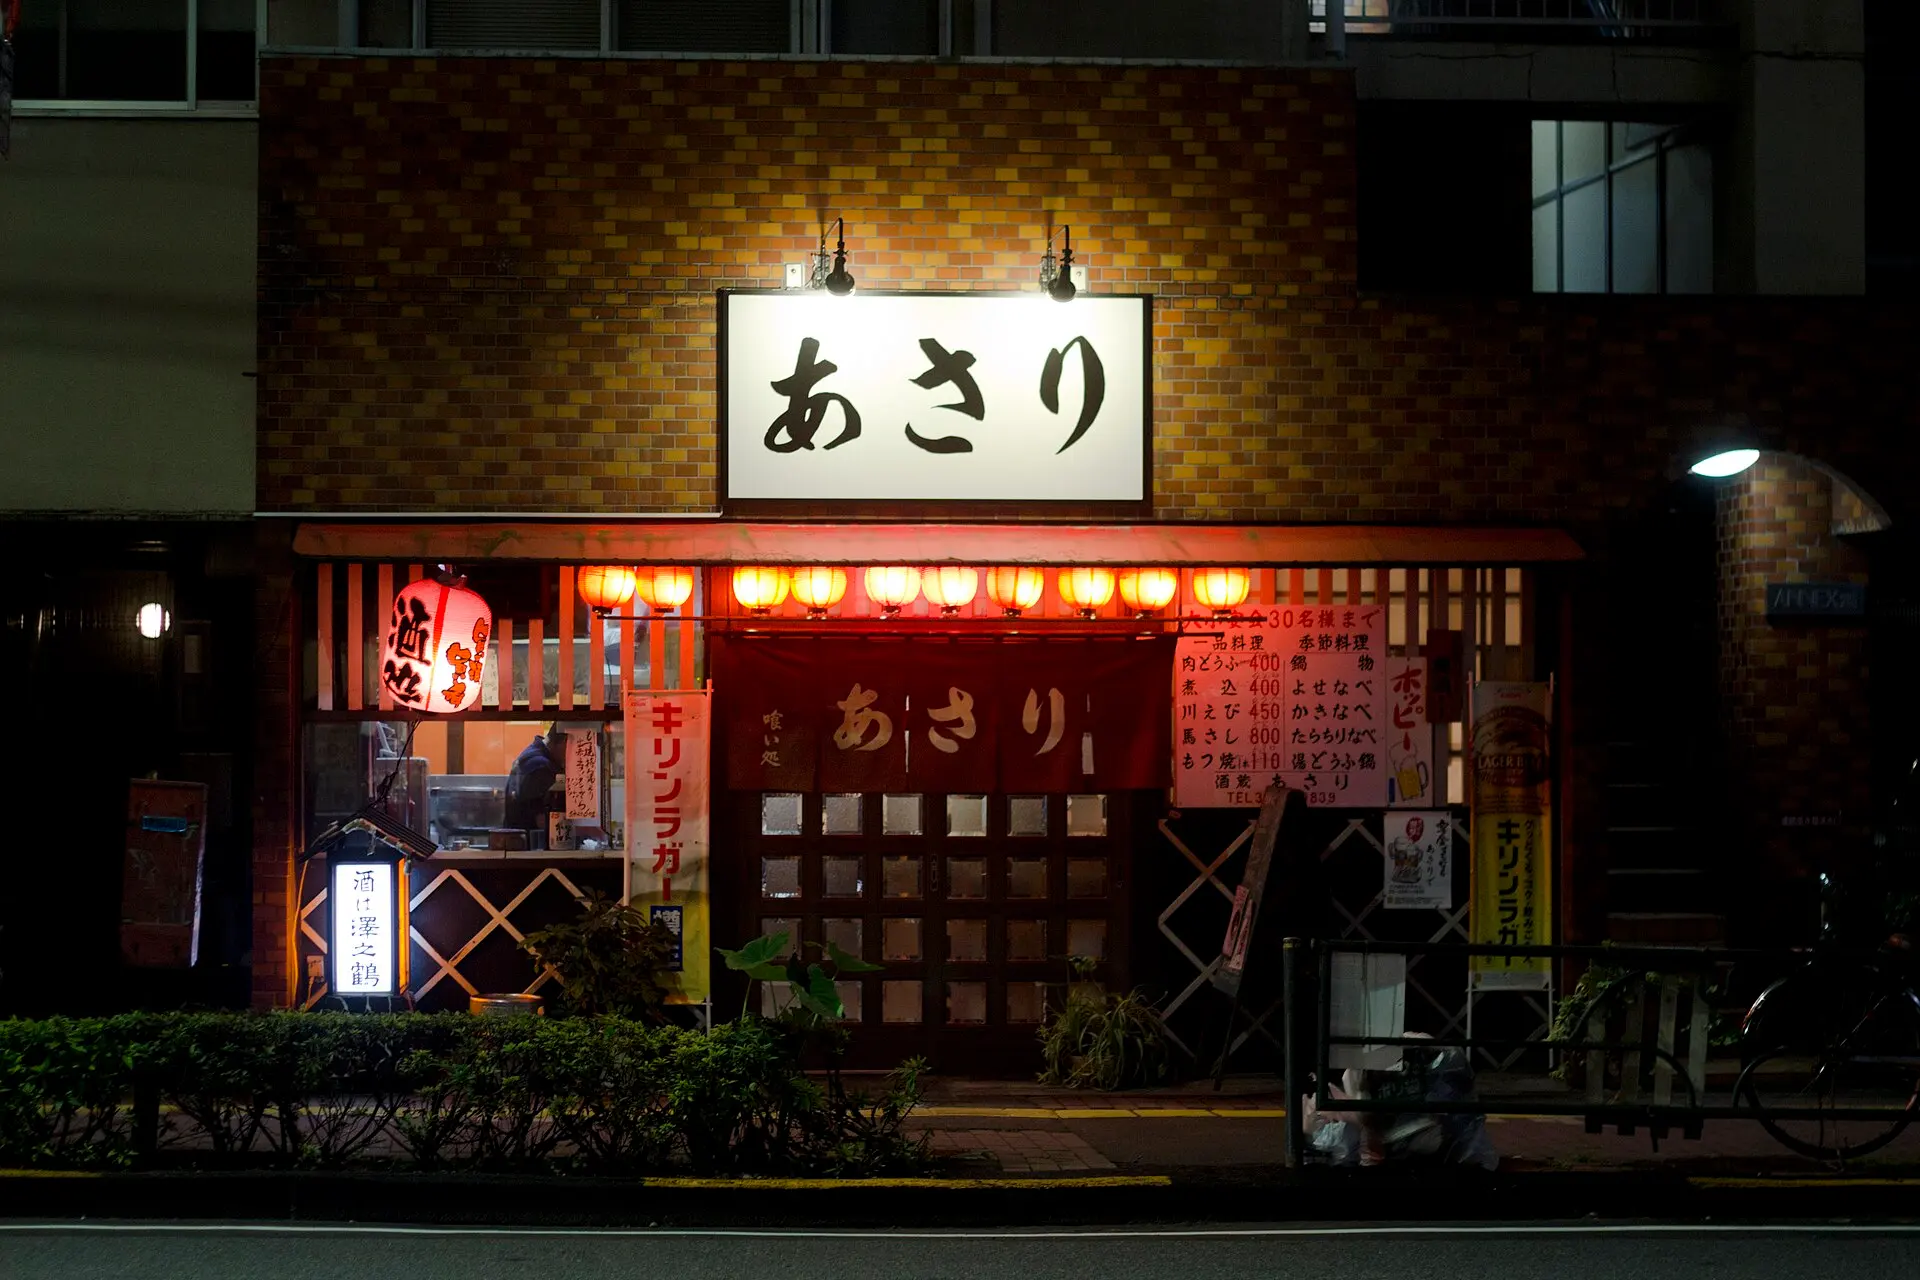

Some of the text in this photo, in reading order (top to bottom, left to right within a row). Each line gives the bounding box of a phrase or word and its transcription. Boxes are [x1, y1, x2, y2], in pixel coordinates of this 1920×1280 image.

[764, 335, 1105, 455] あさり
[1193, 635, 1264, 651] 一品料理
[1298, 635, 1370, 651] 季節料理
[1182, 655, 1280, 672] 肉どうふ 400
[1250, 679, 1280, 695] 400
[1292, 679, 1373, 696] よせなべ
[1181, 703, 1280, 720] 川えび 450
[1291, 703, 1373, 720] かきなべ
[1390, 666, 1424, 751] ホッピー
[833, 682, 1065, 757] あさり
[1182, 728, 1280, 745] 馬さし 800
[1291, 728, 1377, 744] たらちりなべ
[1182, 752, 1236, 770] もつ焼
[1291, 752, 1376, 770] 湯どうふ鍋
[1271, 774, 1349, 790] あさり
[652, 702, 684, 901] キリンラガー
[1498, 819, 1520, 967] キリンラガー
[351, 870, 380, 987] 酒は澤之鶴
